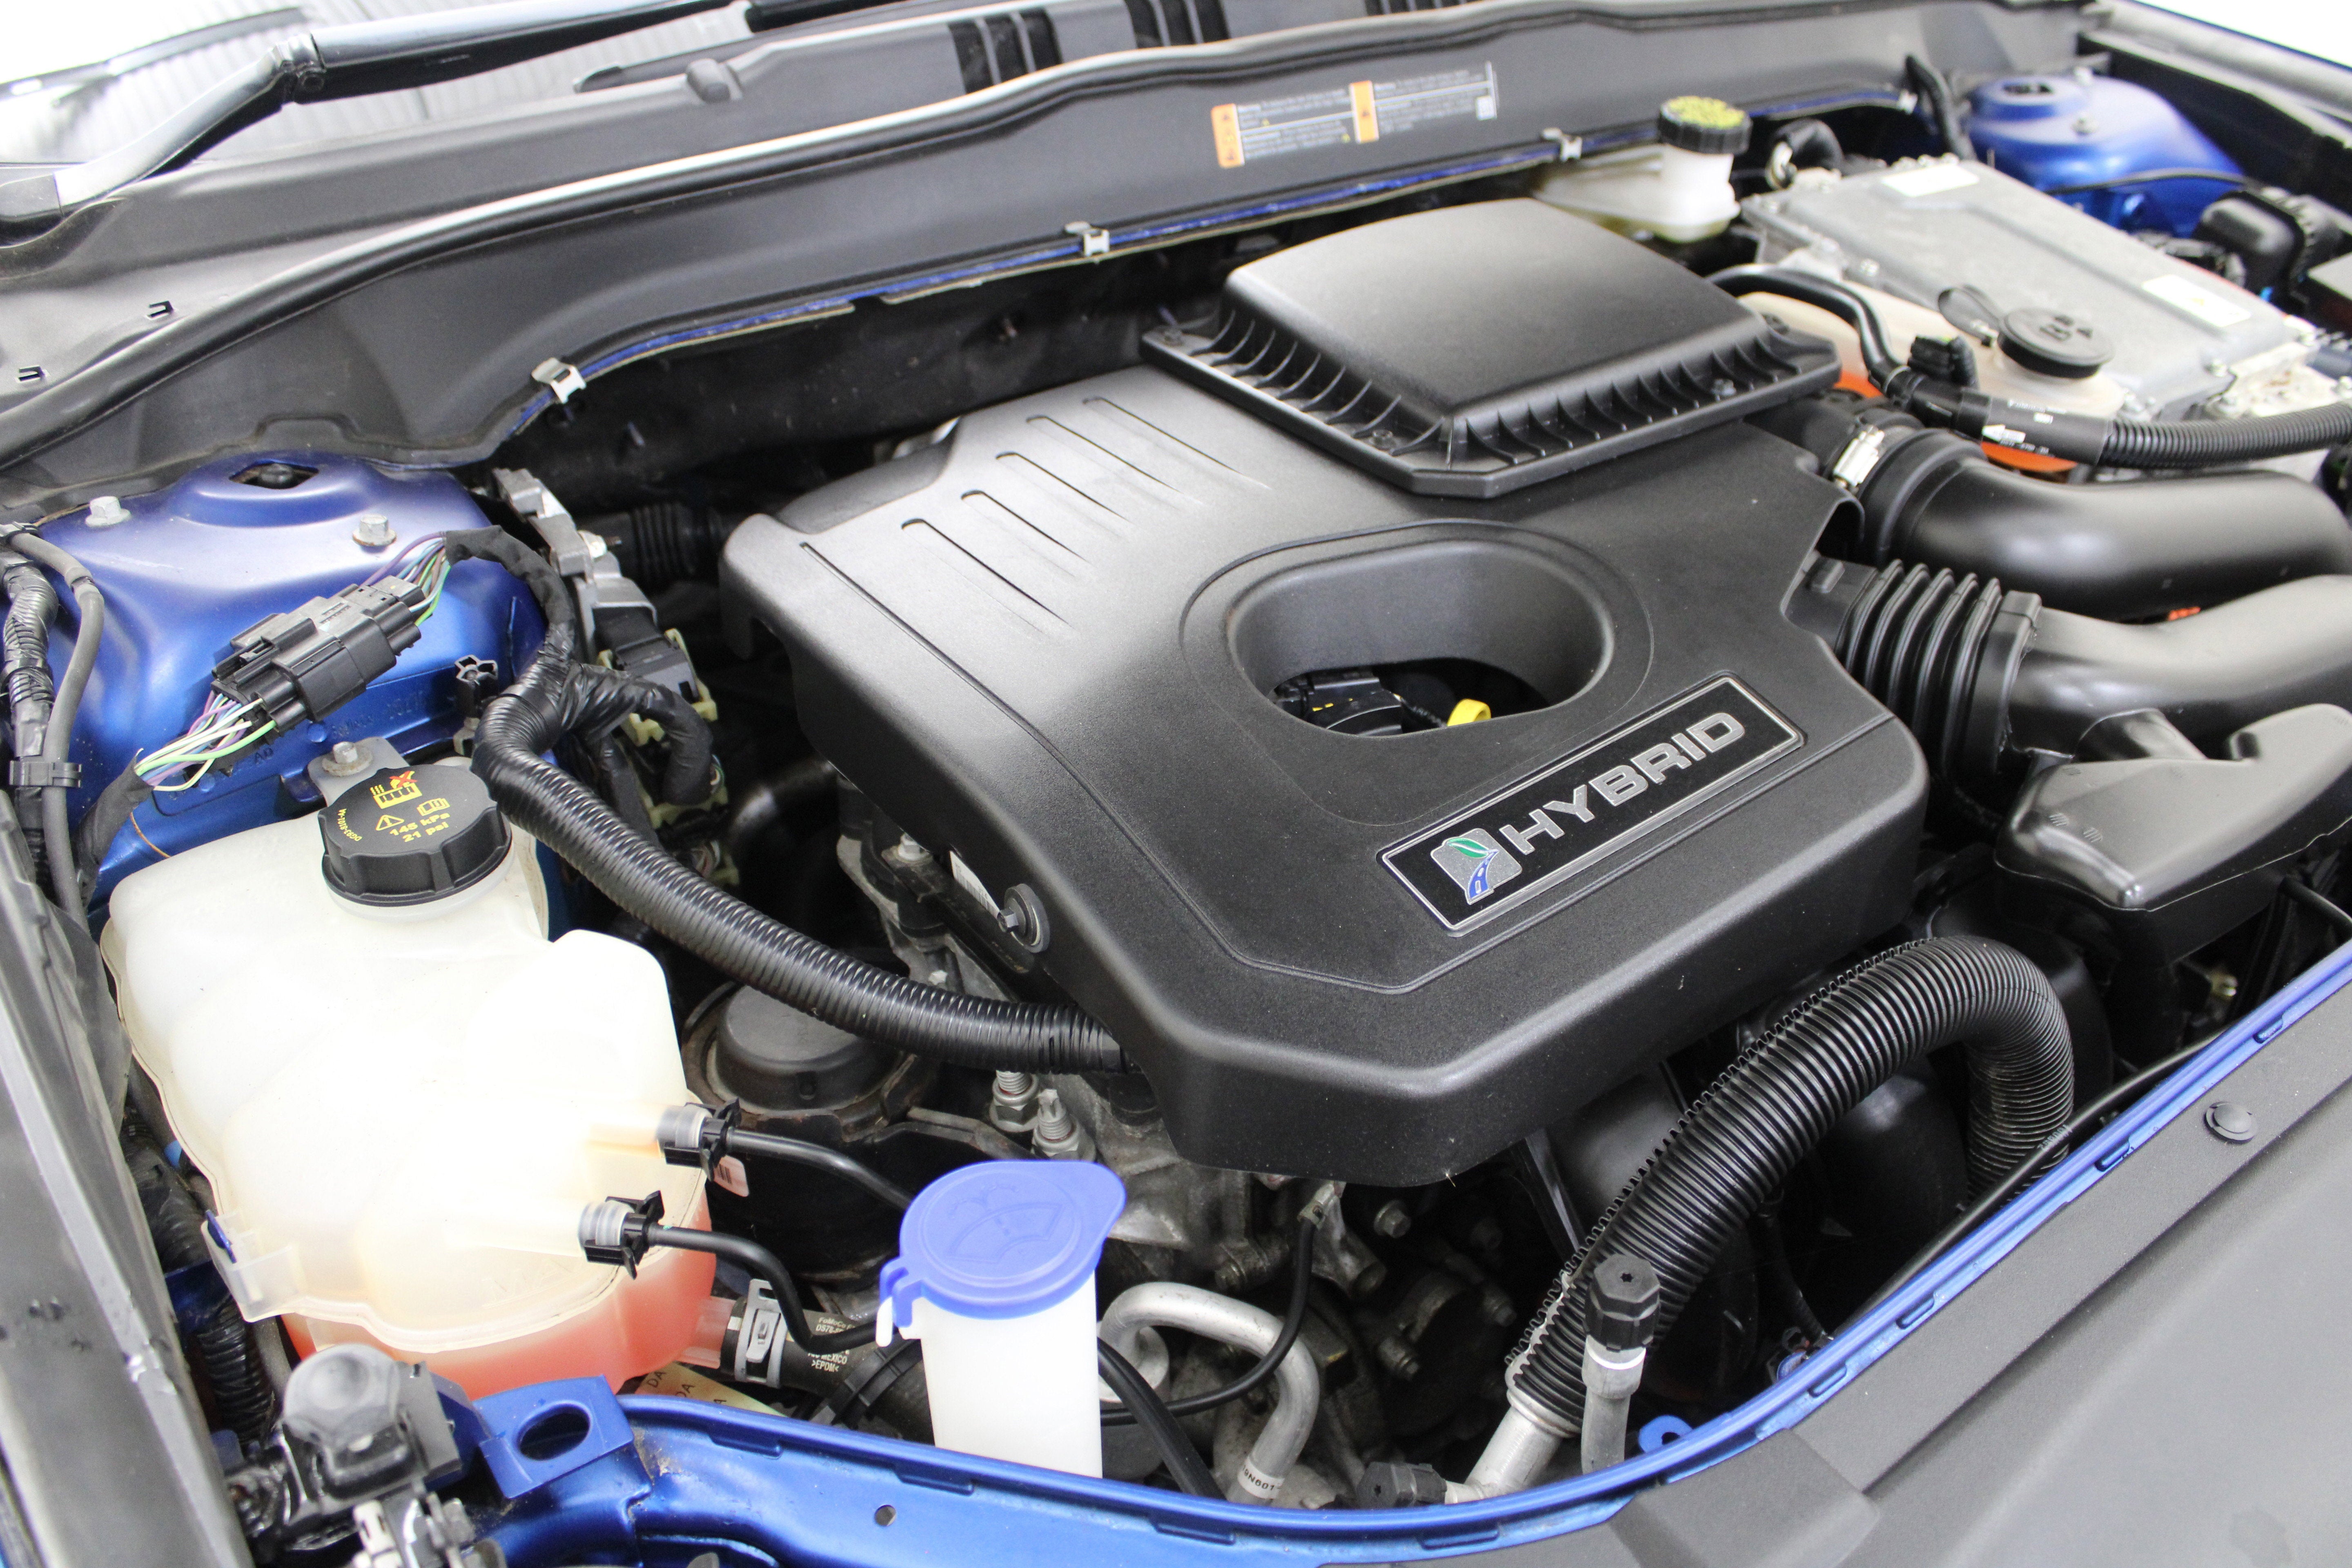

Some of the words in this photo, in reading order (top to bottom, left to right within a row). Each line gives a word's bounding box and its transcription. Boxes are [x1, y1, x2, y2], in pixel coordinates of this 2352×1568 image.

[1499, 712, 1745, 855] HYBRID
[337, 808, 363, 842] DG93-8101-AA
[390, 822, 418, 836] 145
[419, 813, 451, 826] kPa
[402, 831, 422, 842] 21
[425, 822, 450, 835] psi
[821, 1354, 848, 1365] MEXICO
[646, 1371, 666, 1388] DA
